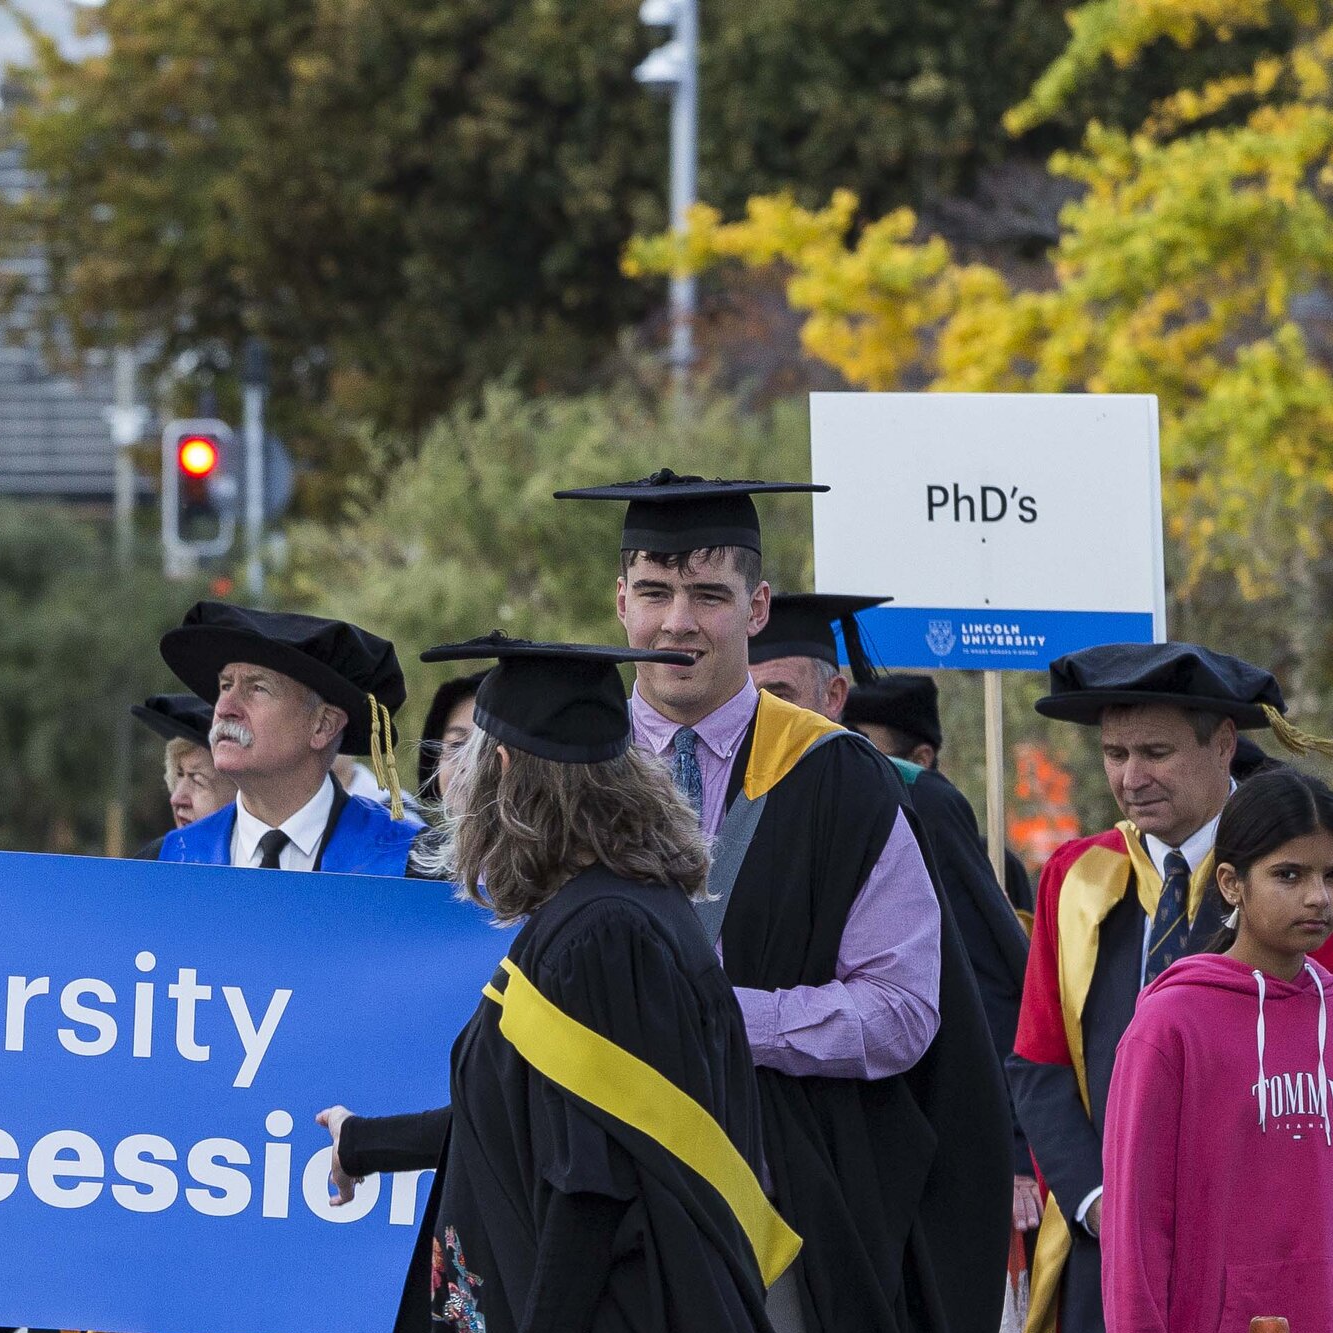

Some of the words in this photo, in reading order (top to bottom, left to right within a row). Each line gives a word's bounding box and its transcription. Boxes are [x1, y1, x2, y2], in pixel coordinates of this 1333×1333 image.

[926, 482, 1038, 524] PhD's
[961, 623, 1020, 635] LINCOLN
[961, 635, 1046, 647] UNIVERSITY
